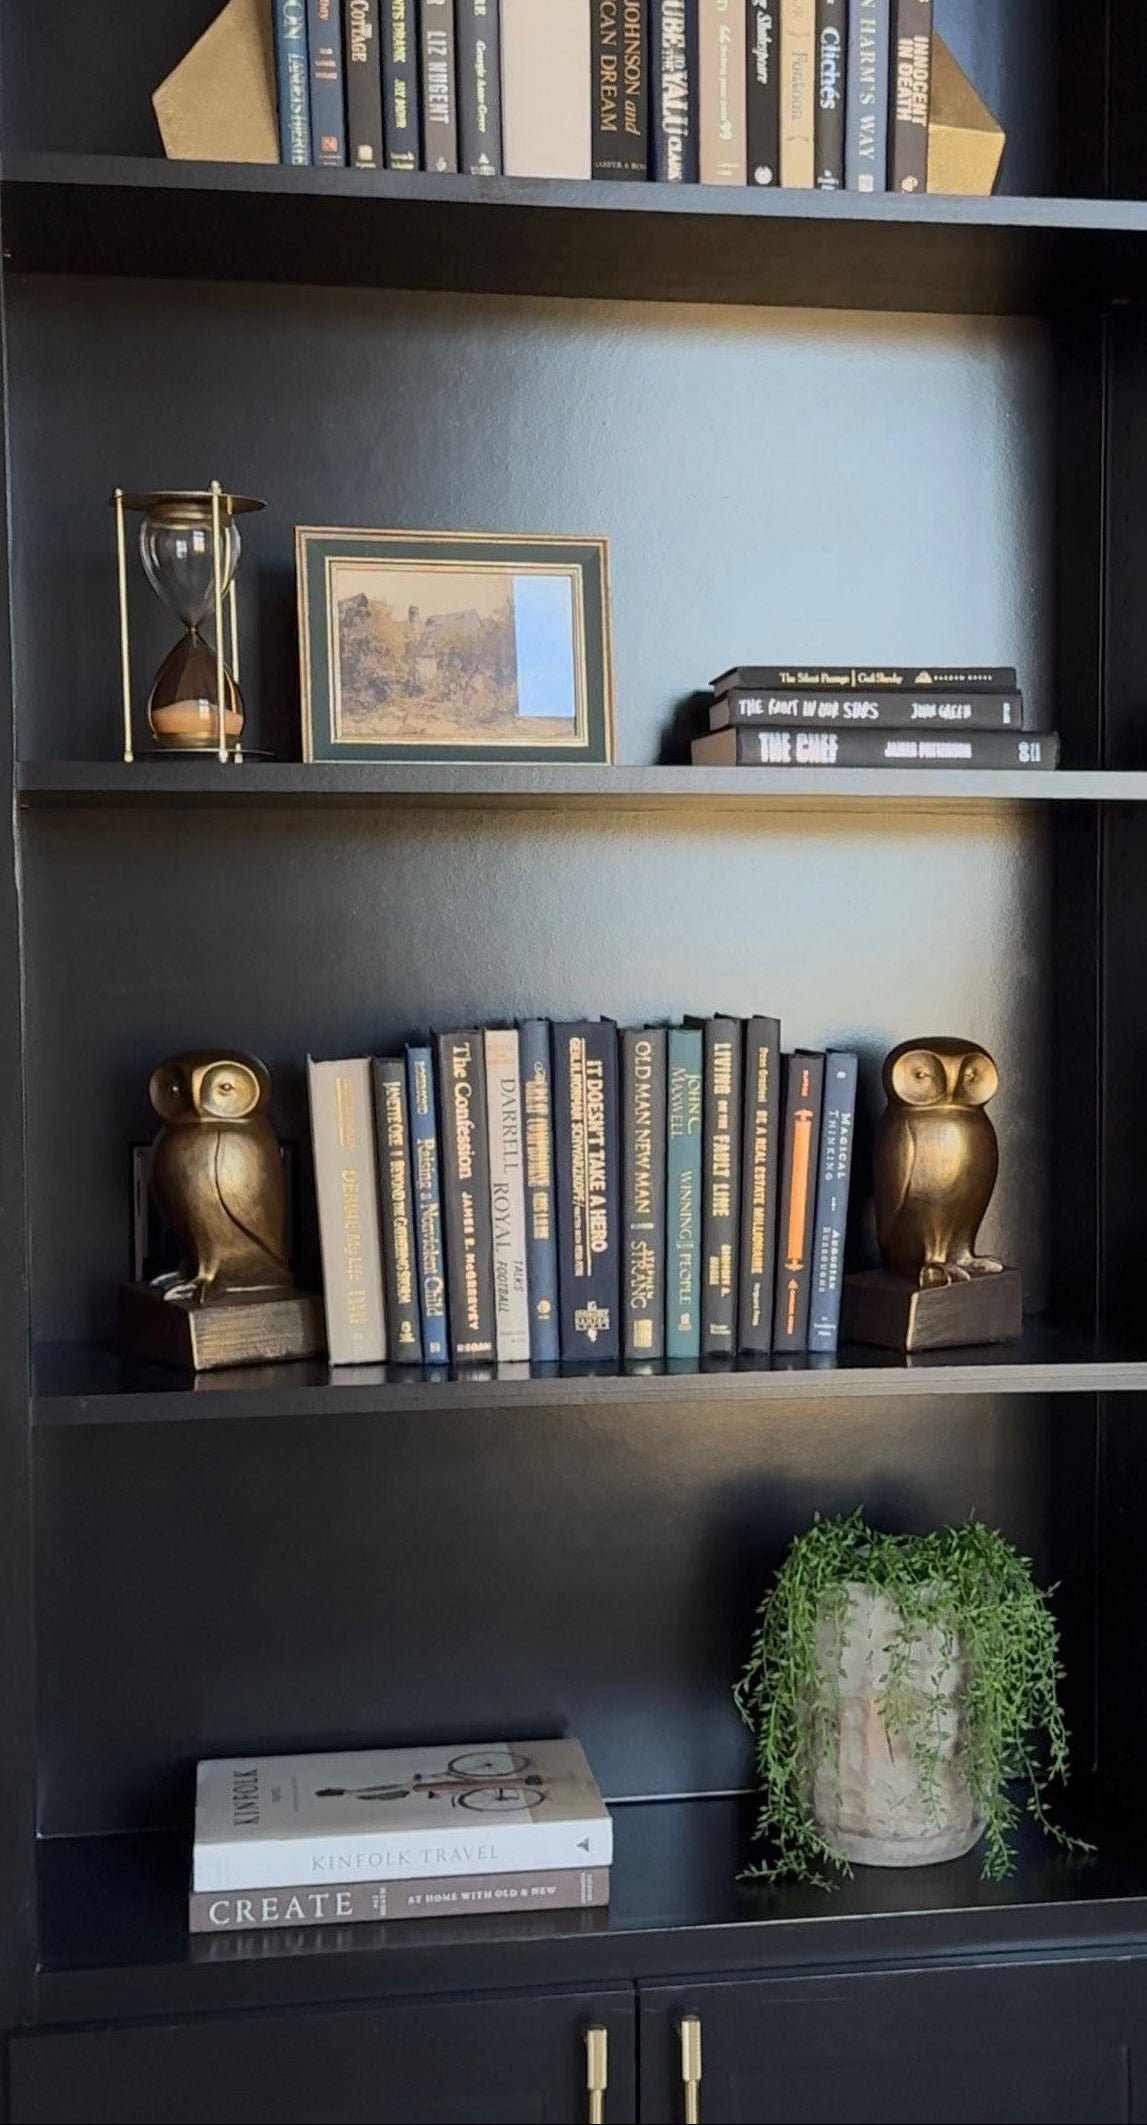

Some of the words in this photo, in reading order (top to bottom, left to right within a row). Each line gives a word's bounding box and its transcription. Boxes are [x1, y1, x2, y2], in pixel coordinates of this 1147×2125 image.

[427, 31, 447, 55] LIZ
[859, 19, 876, 105] HARM'S
[898, 37, 914, 61] IN
[820, 26, 841, 110] Clichés
[911, 34, 930, 127] INNOCENT
[428, 62, 449, 124] NUGENT
[600, 55, 618, 132] DREAM
[661, 71, 689, 136] YALU
[896, 62, 913, 121] DEATH
[624, 101, 640, 136] and
[858, 115, 876, 161] WAY
[779, 672, 796, 684] The
[739, 698, 764, 716] THE
[802, 699, 816, 717] IN
[843, 701, 879, 719] STARS
[758, 732, 791, 763] THE
[453, 1041, 473, 1079] The
[586, 1060, 602, 1077] IT
[635, 1041, 651, 1079] OLD
[713, 1043, 732, 1095] LIVING
[587, 1079, 605, 1145] DOESN'T
[635, 1083, 651, 1128] MAN
[670, 1066, 686, 1140] MAXWELL
[685, 1074, 701, 1113] JOHN
[454, 1082, 476, 1180] Confession
[501, 1078, 519, 1174] DARRELL
[755, 1110, 769, 1124] BE
[755, 1127, 768, 1135] A
[417, 1138, 435, 1189] Raising
[635, 1130, 651, 1168] NEW
[713, 1134, 731, 1178] FAULT
[754, 1137, 767, 1164] REAL
[825, 1109, 839, 1181] THINKING
[837, 1112, 852, 1179] MAGICAL
[588, 1150, 606, 1192] TAKE
[635, 1171, 651, 1214] MAN
[753, 1166, 767, 1205] ESTATE
[462, 1191, 475, 1234] JAMES
[492, 1182, 512, 1252] ROYAL
[590, 1194, 607, 1207] A
[679, 1171, 694, 1239] WINNING
[712, 1183, 731, 1217] LINE
[420, 1203, 440, 1275] Nonviolent
[590, 1209, 608, 1253] HERO
[751, 1207, 765, 1275] MILLIONAIRE
[630, 1241, 647, 1309] STRANG
[679, 1253, 692, 1305] PEOPLE
[828, 1229, 841, 1289] AUGUSTEN
[424, 1276, 444, 1317] Child
[497, 1260, 510, 1313] FOOTBALL
[233, 1768, 260, 1827] KINFOLK
[312, 1850, 411, 1871] KINFOLK
[422, 1844, 500, 1863] TRAVEL
[209, 1892, 353, 1925] CREATE
[407, 1894, 422, 1905] AT
[425, 1893, 458, 1904] HOME
[461, 1889, 492, 1901] WITH
[494, 1888, 518, 1898] OLD
[531, 1886, 557, 1896] NEW
